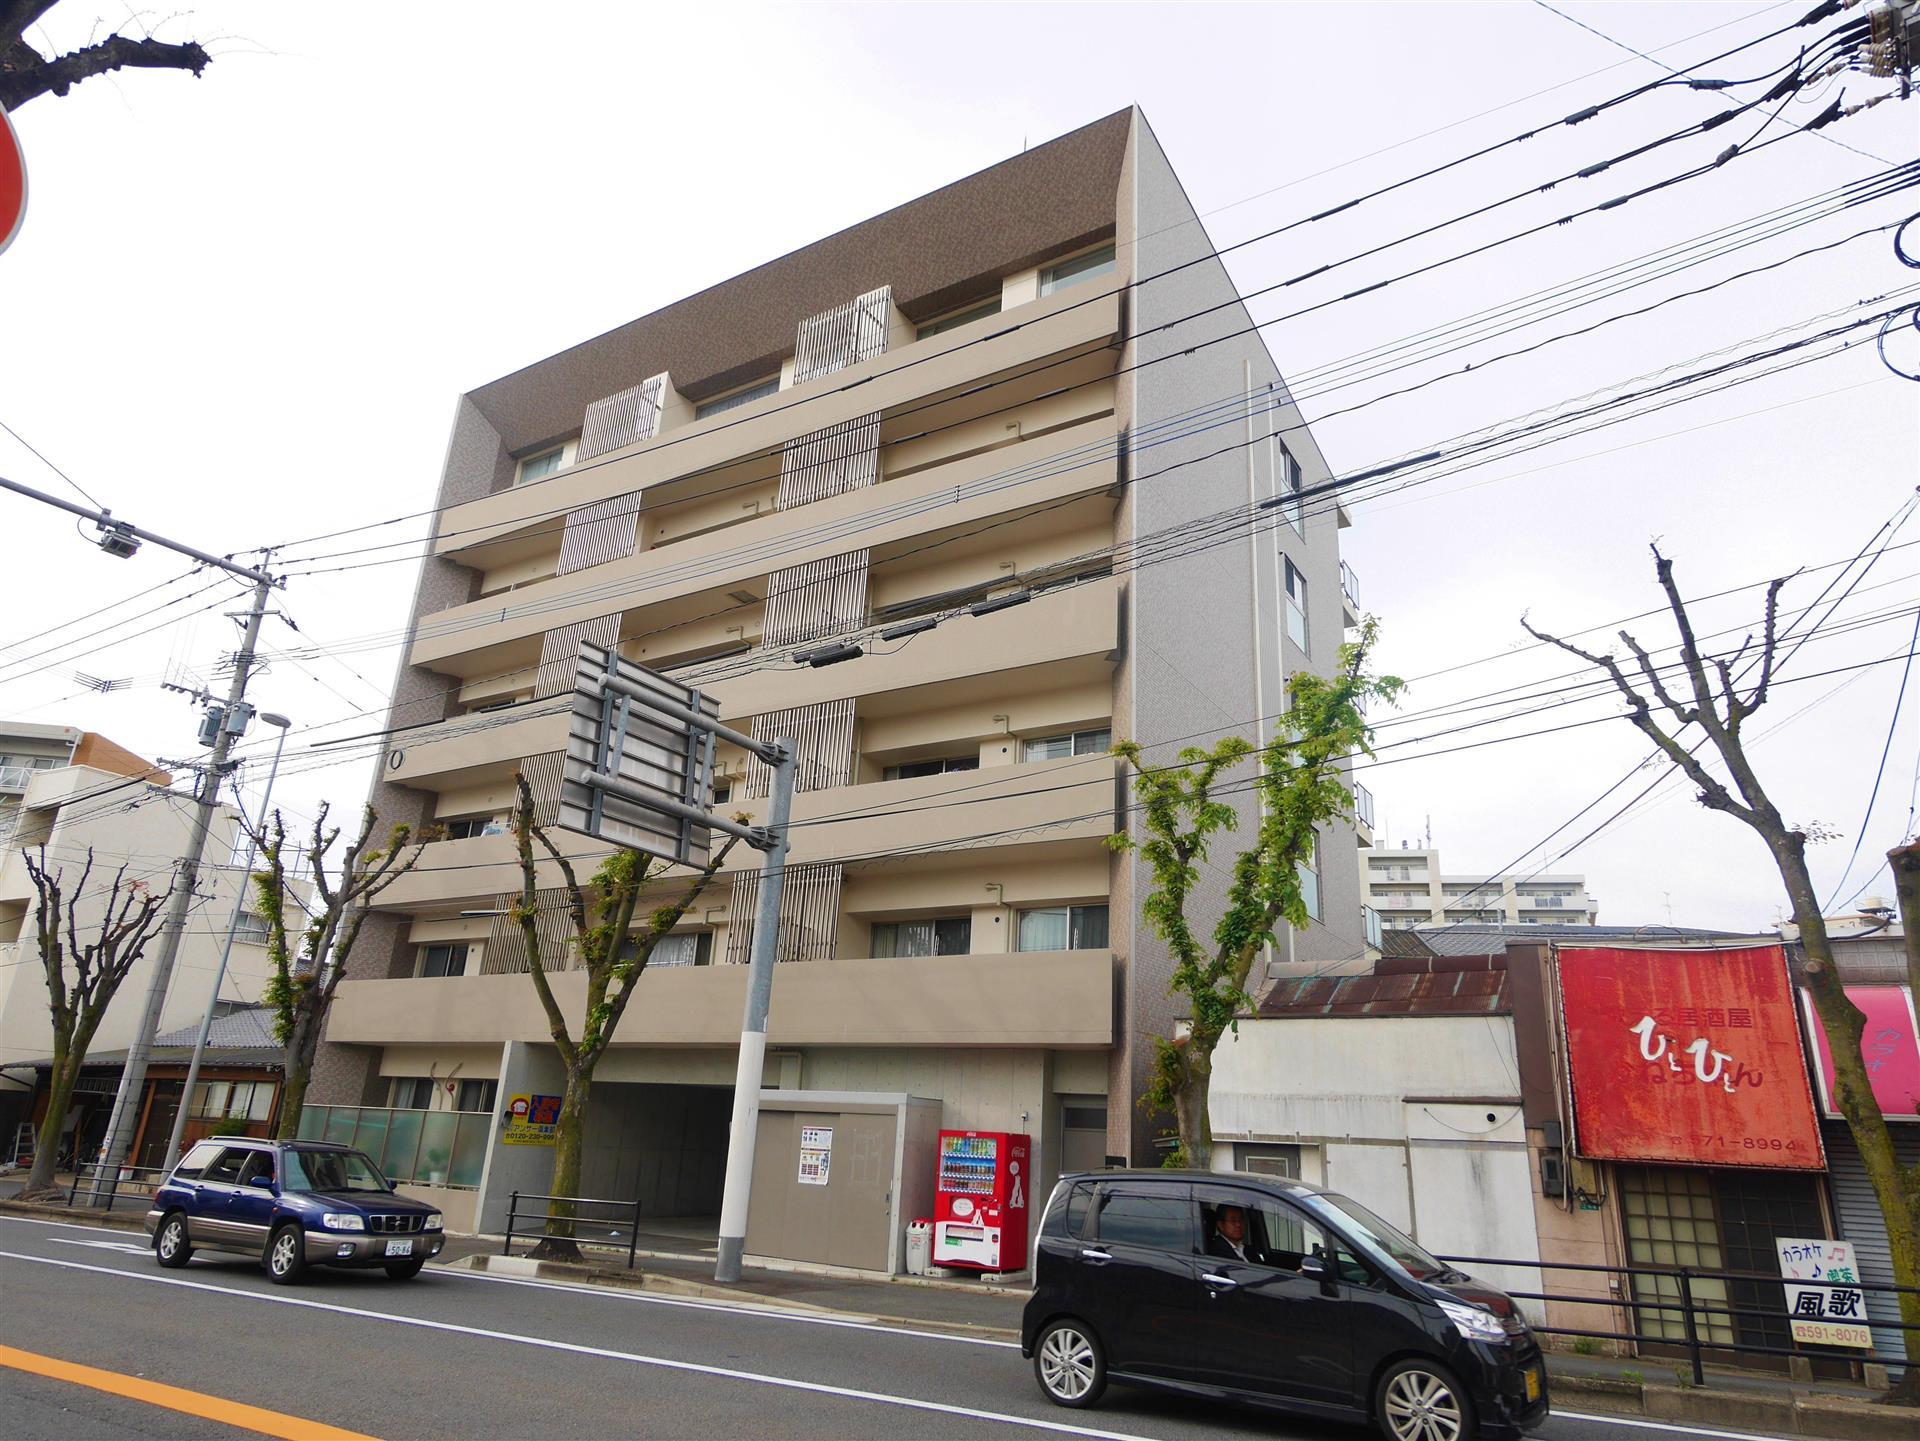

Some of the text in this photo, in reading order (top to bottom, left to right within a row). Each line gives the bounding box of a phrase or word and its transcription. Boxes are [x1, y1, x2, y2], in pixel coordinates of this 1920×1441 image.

[1782, 1242, 1822, 1263] カラオケ
[1793, 1289, 1861, 1317] 風歌
[1807, 1326, 1868, 1343] 591-8076
